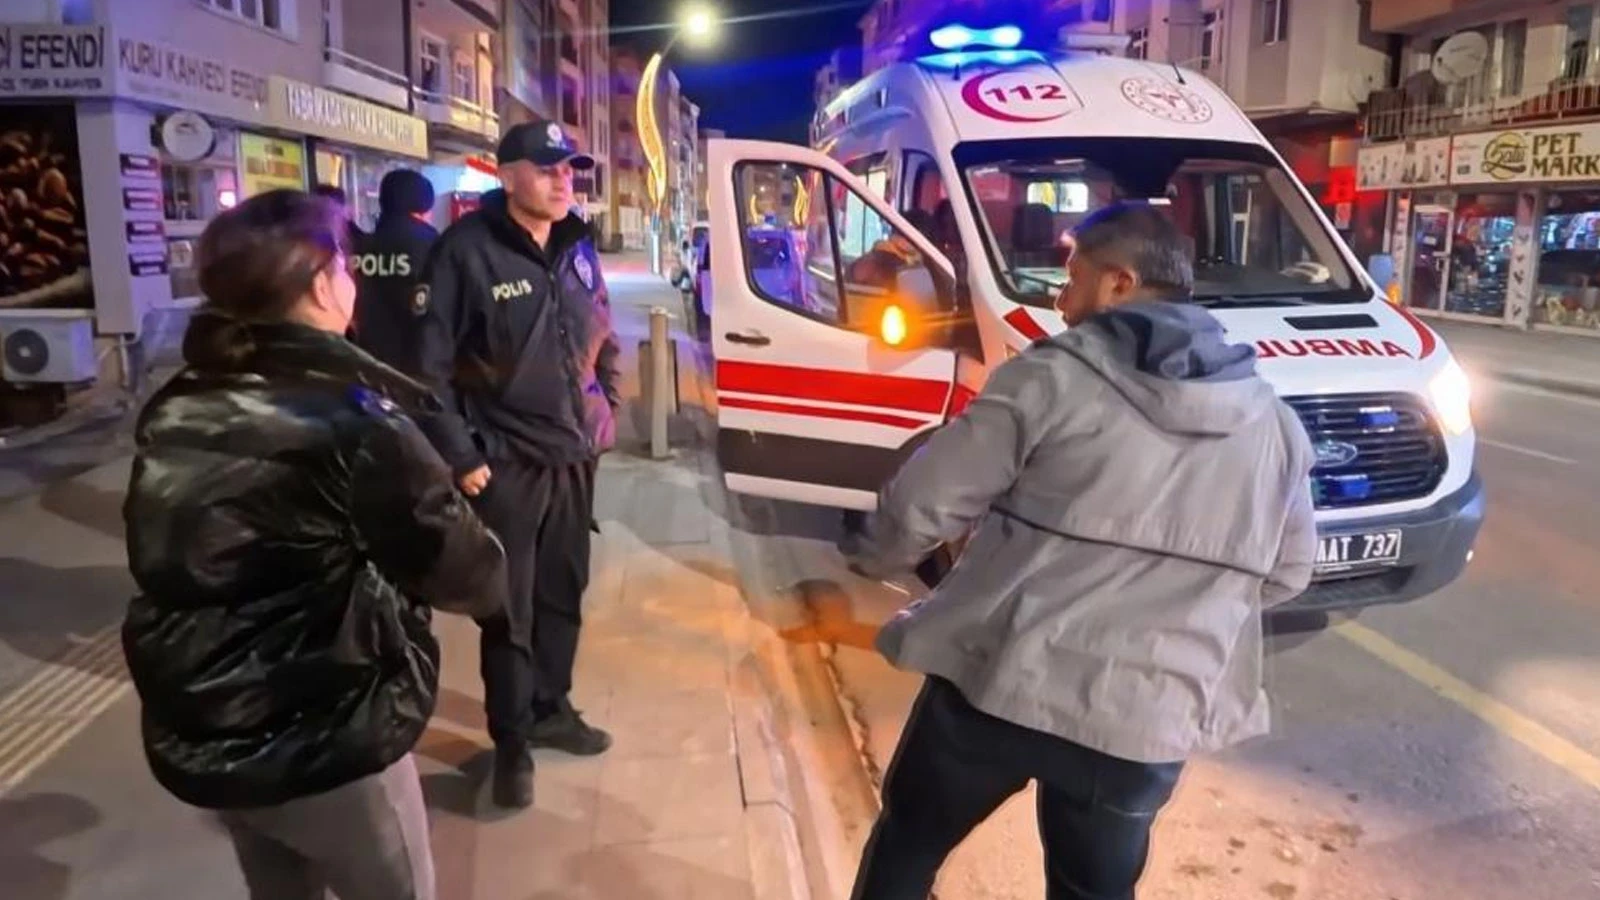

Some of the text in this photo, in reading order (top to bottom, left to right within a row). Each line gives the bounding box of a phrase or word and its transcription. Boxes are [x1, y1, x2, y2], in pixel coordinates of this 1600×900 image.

[118, 39, 161, 78] KURU
[984, 84, 1067, 103] 112
[1533, 132, 1582, 155] PET
[1530, 155, 1600, 177] MARK
[1362, 533, 1398, 559] 737
